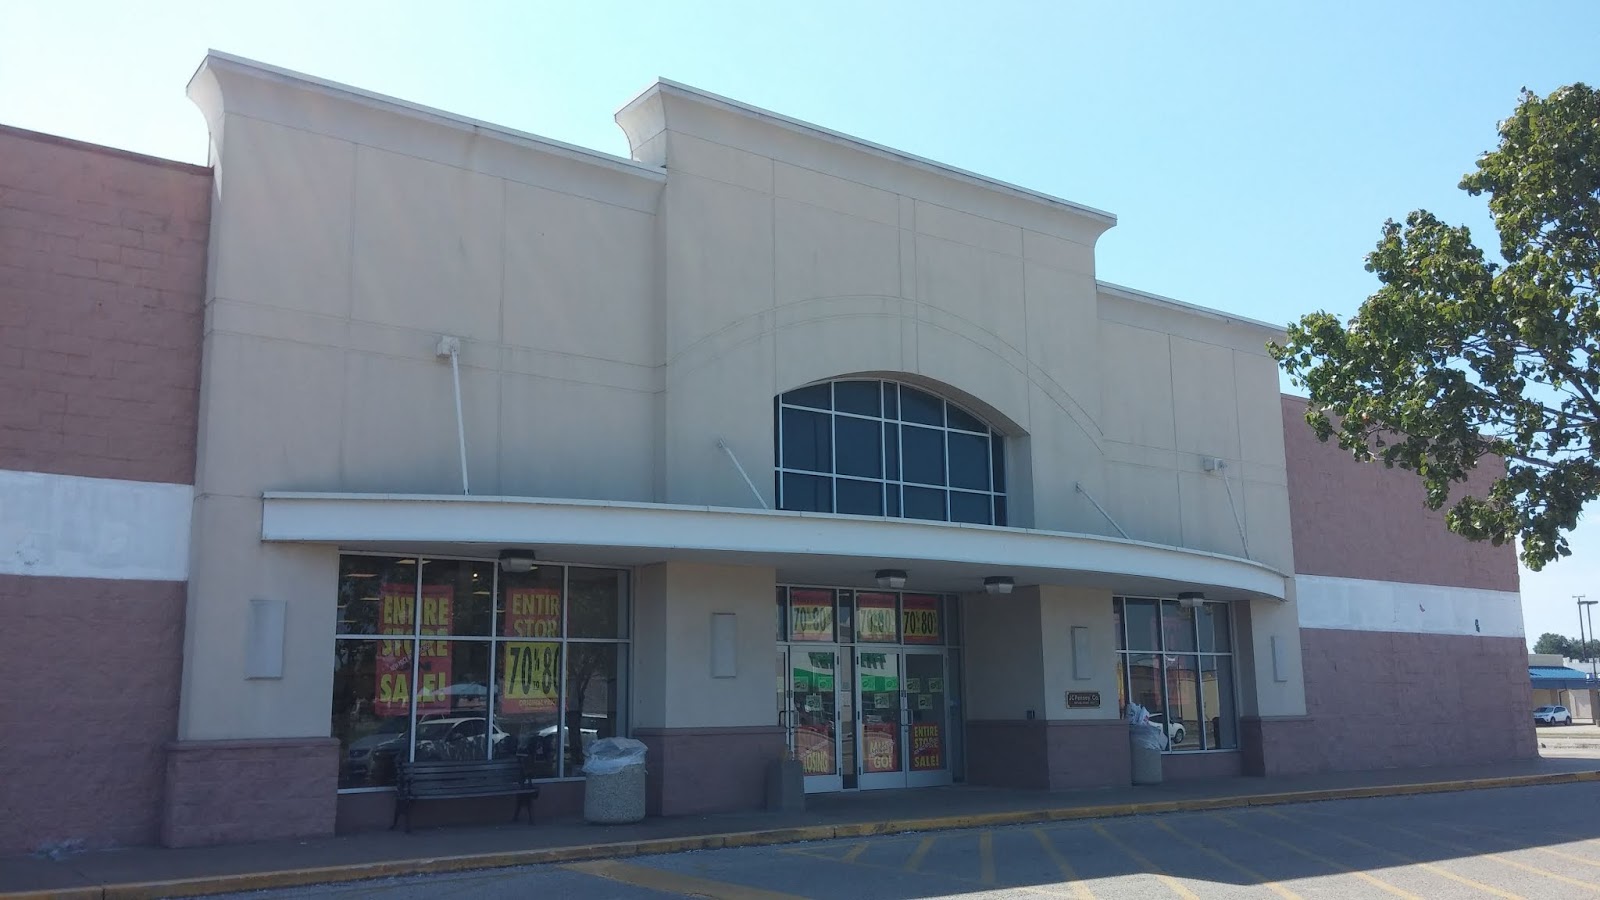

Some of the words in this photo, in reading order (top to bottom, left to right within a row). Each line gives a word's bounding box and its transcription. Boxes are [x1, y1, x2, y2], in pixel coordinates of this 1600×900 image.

[384, 595, 448, 626] ENTRE
[512, 593, 560, 615] ENTIR
[513, 619, 558, 638] STOR
[380, 672, 446, 702] SAE!
[914, 726, 939, 737] ENTIRE
[803, 752, 828, 773] LOSING
[874, 756, 893, 769] GO!
[914, 755, 939, 768] SALE!
